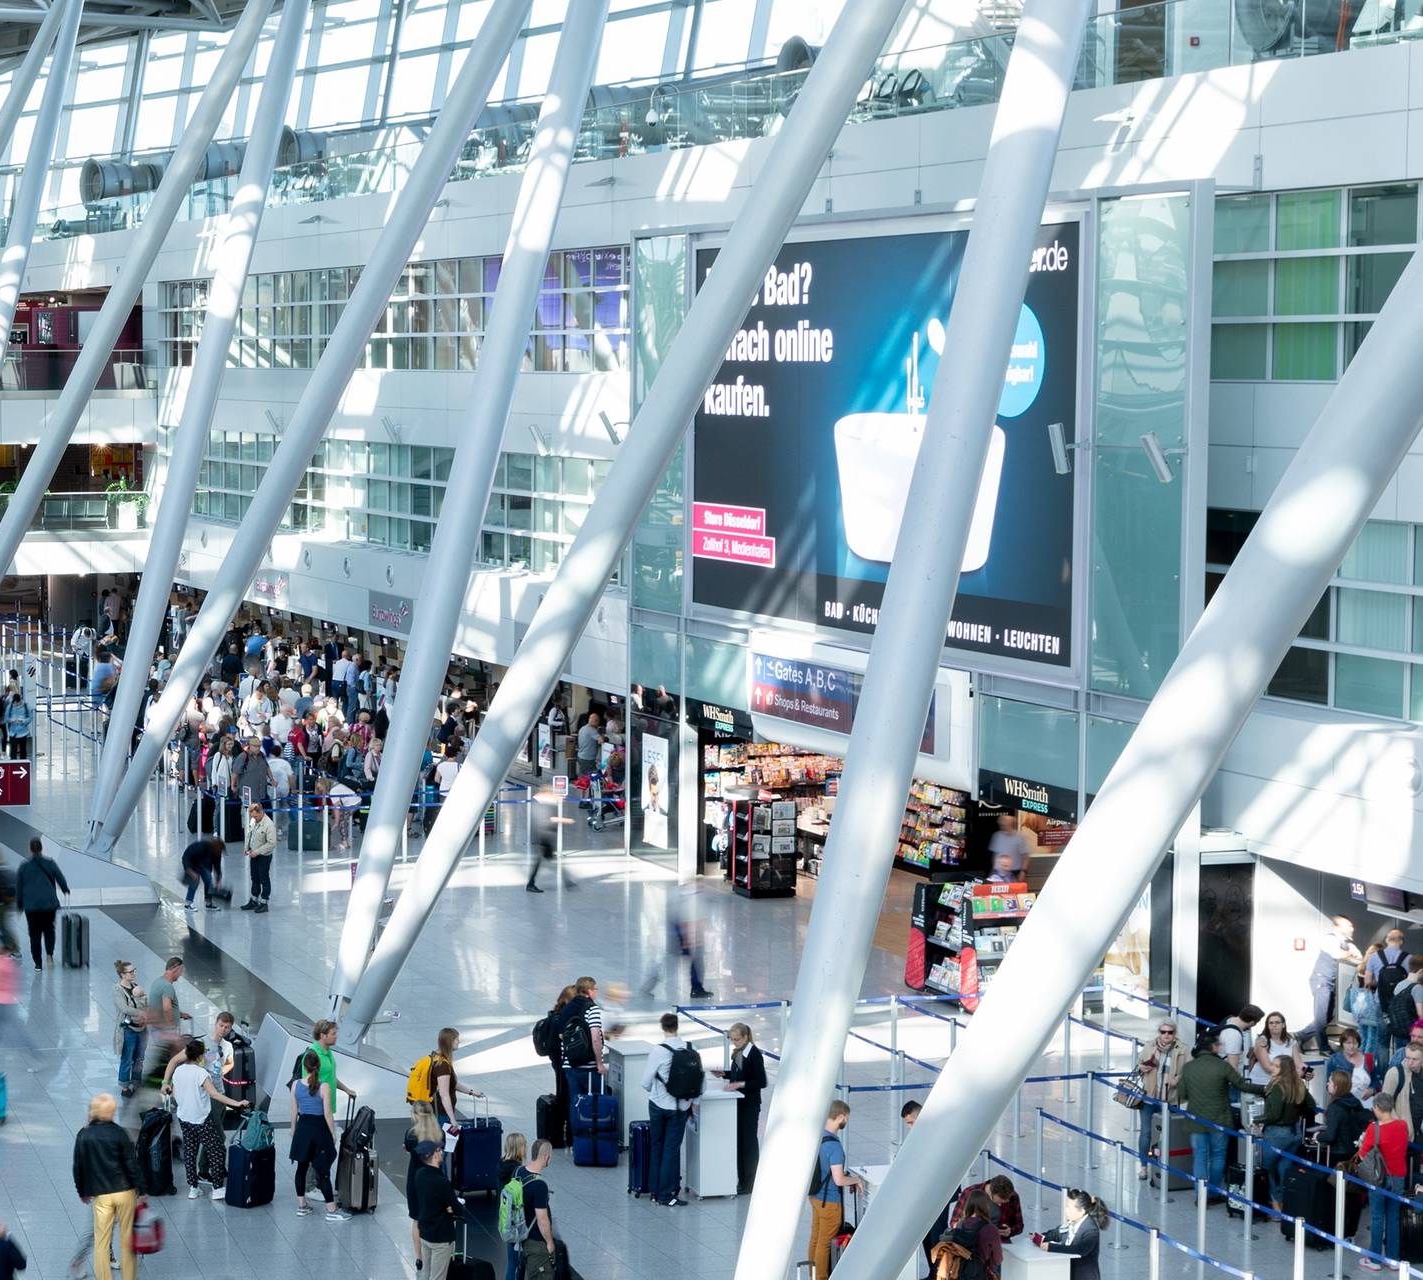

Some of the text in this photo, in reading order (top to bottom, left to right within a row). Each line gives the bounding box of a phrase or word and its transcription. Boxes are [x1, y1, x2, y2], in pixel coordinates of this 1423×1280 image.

[764, 262, 812, 305] Bad?
[775, 320, 833, 362] online
[704, 375, 769, 417] kaufen.
[704, 510, 761, 531] Store Düsseldorf
[724, 539, 731, 556] 3,
[731, 540, 770, 560] Medienhafen
[825, 601, 1060, 655] BAD KÜCH WOHNEN LEUCHTEN
[775, 662, 836, 692] Gates A,B,C
[703, 704, 733, 724] WHSmith
[774, 694, 839, 720] Shops & Restaurants
[715, 721, 733, 732] EXPRESS
[1004, 777, 1049, 803] WHSmith
[1022, 799, 1048, 813] EXPRESS
